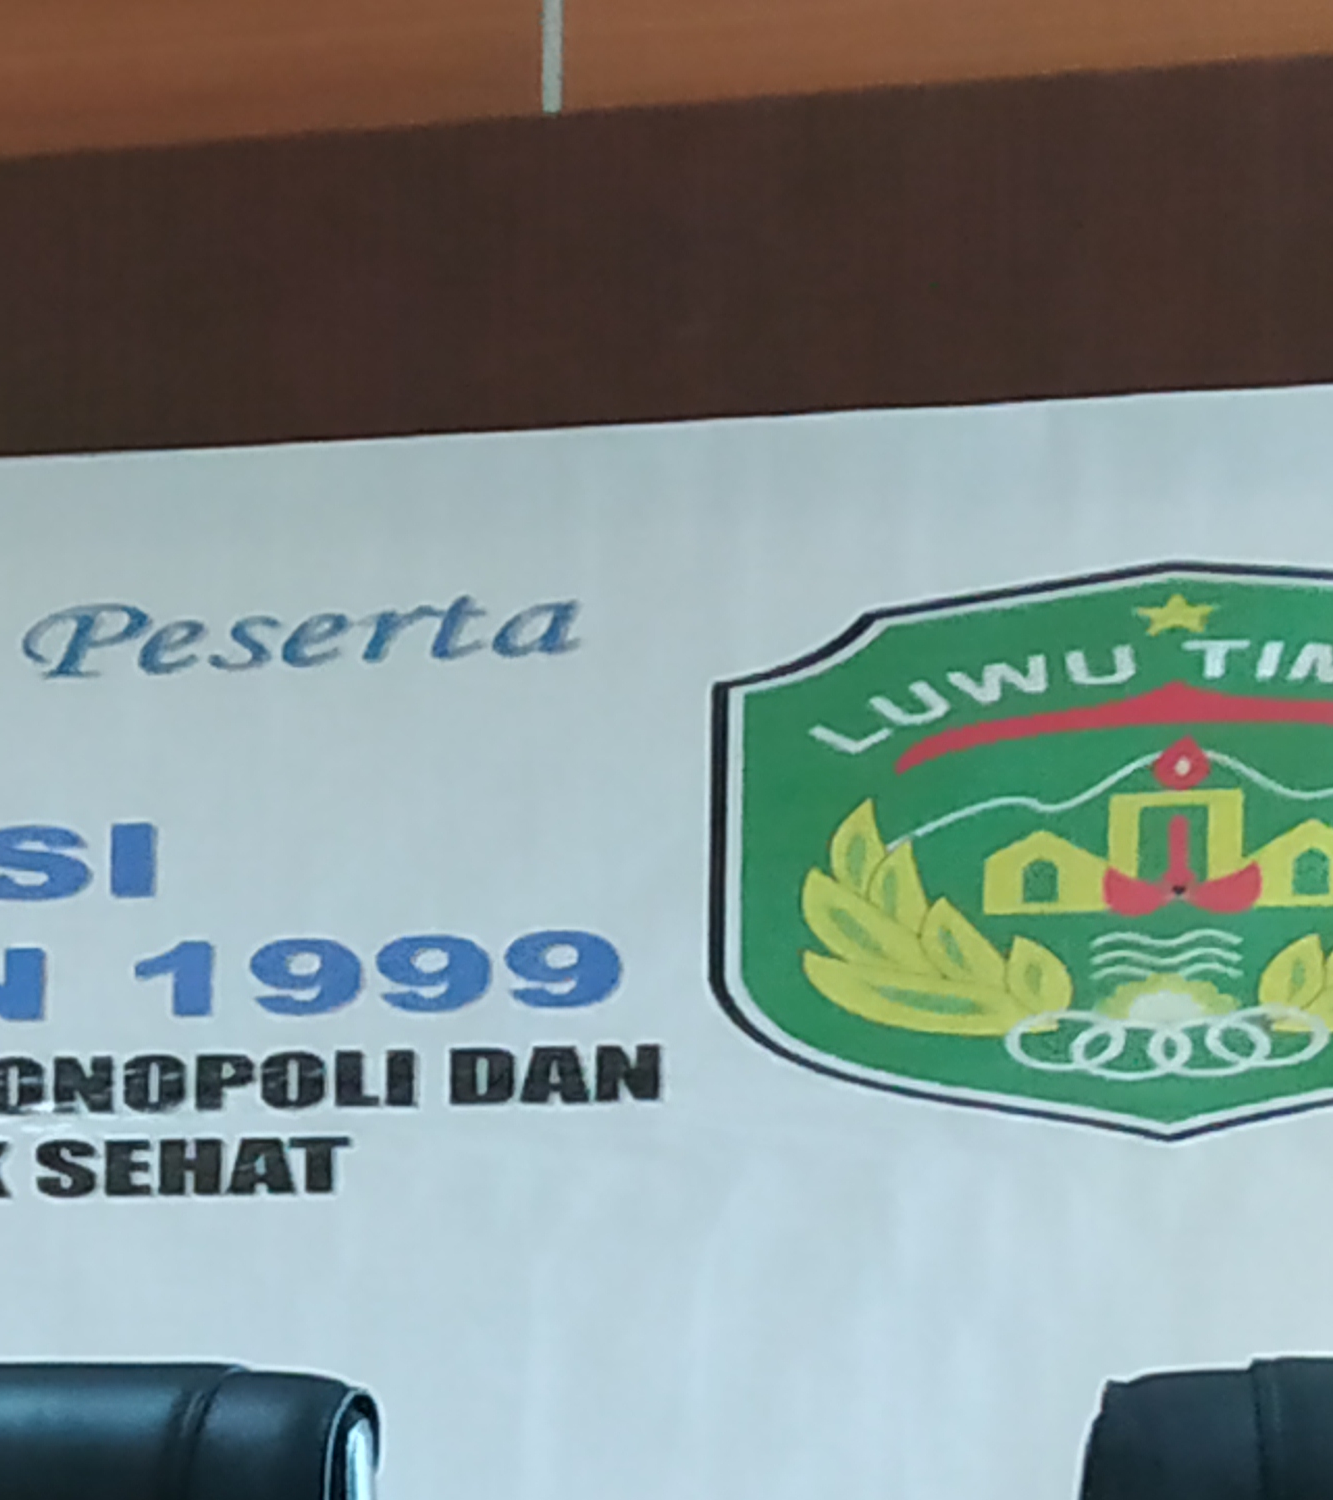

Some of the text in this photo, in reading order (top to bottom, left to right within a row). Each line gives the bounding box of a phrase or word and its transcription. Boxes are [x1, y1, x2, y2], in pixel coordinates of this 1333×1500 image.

[21, 594, 583, 682] Peserta
[807, 643, 1135, 755] LUWU
[135, 929, 623, 1018] 1999
[448, 1043, 663, 1104] DAN
[33, 1135, 351, 1197] SEHAT
